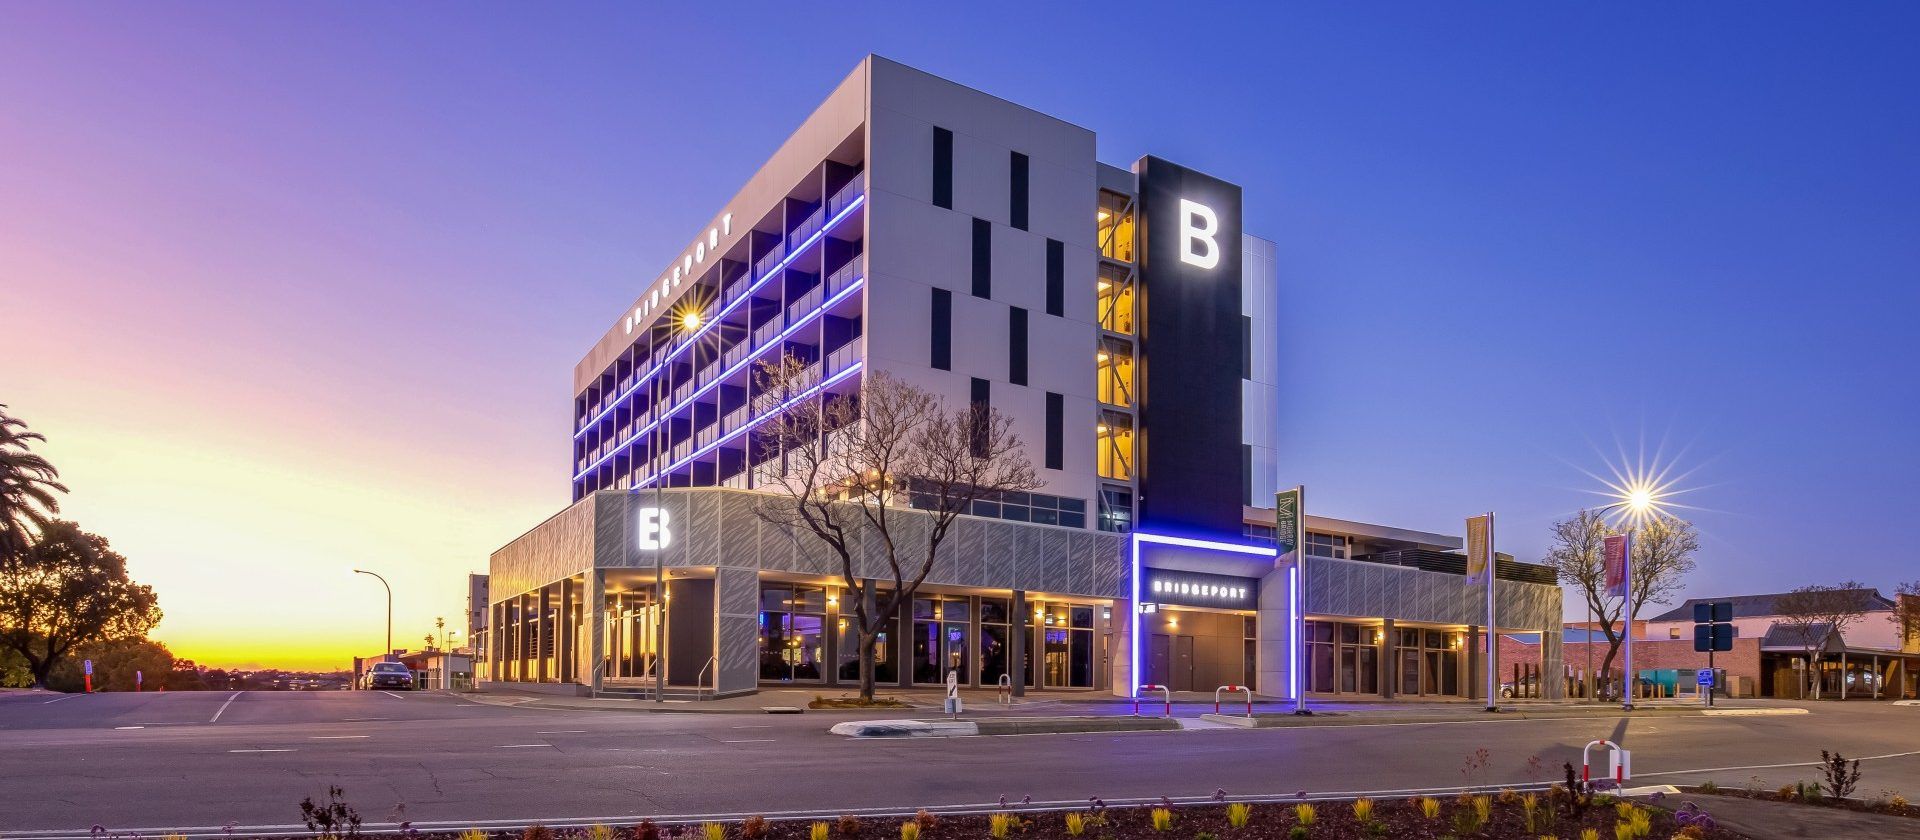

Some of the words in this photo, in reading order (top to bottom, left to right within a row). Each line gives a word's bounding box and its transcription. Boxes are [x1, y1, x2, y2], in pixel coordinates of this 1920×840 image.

[1180, 198, 1220, 270] B
[626, 212, 733, 335] BRIDGEPORT
[639, 507, 671, 550] B
[1153, 580, 1246, 599] BRIDGEPORT
